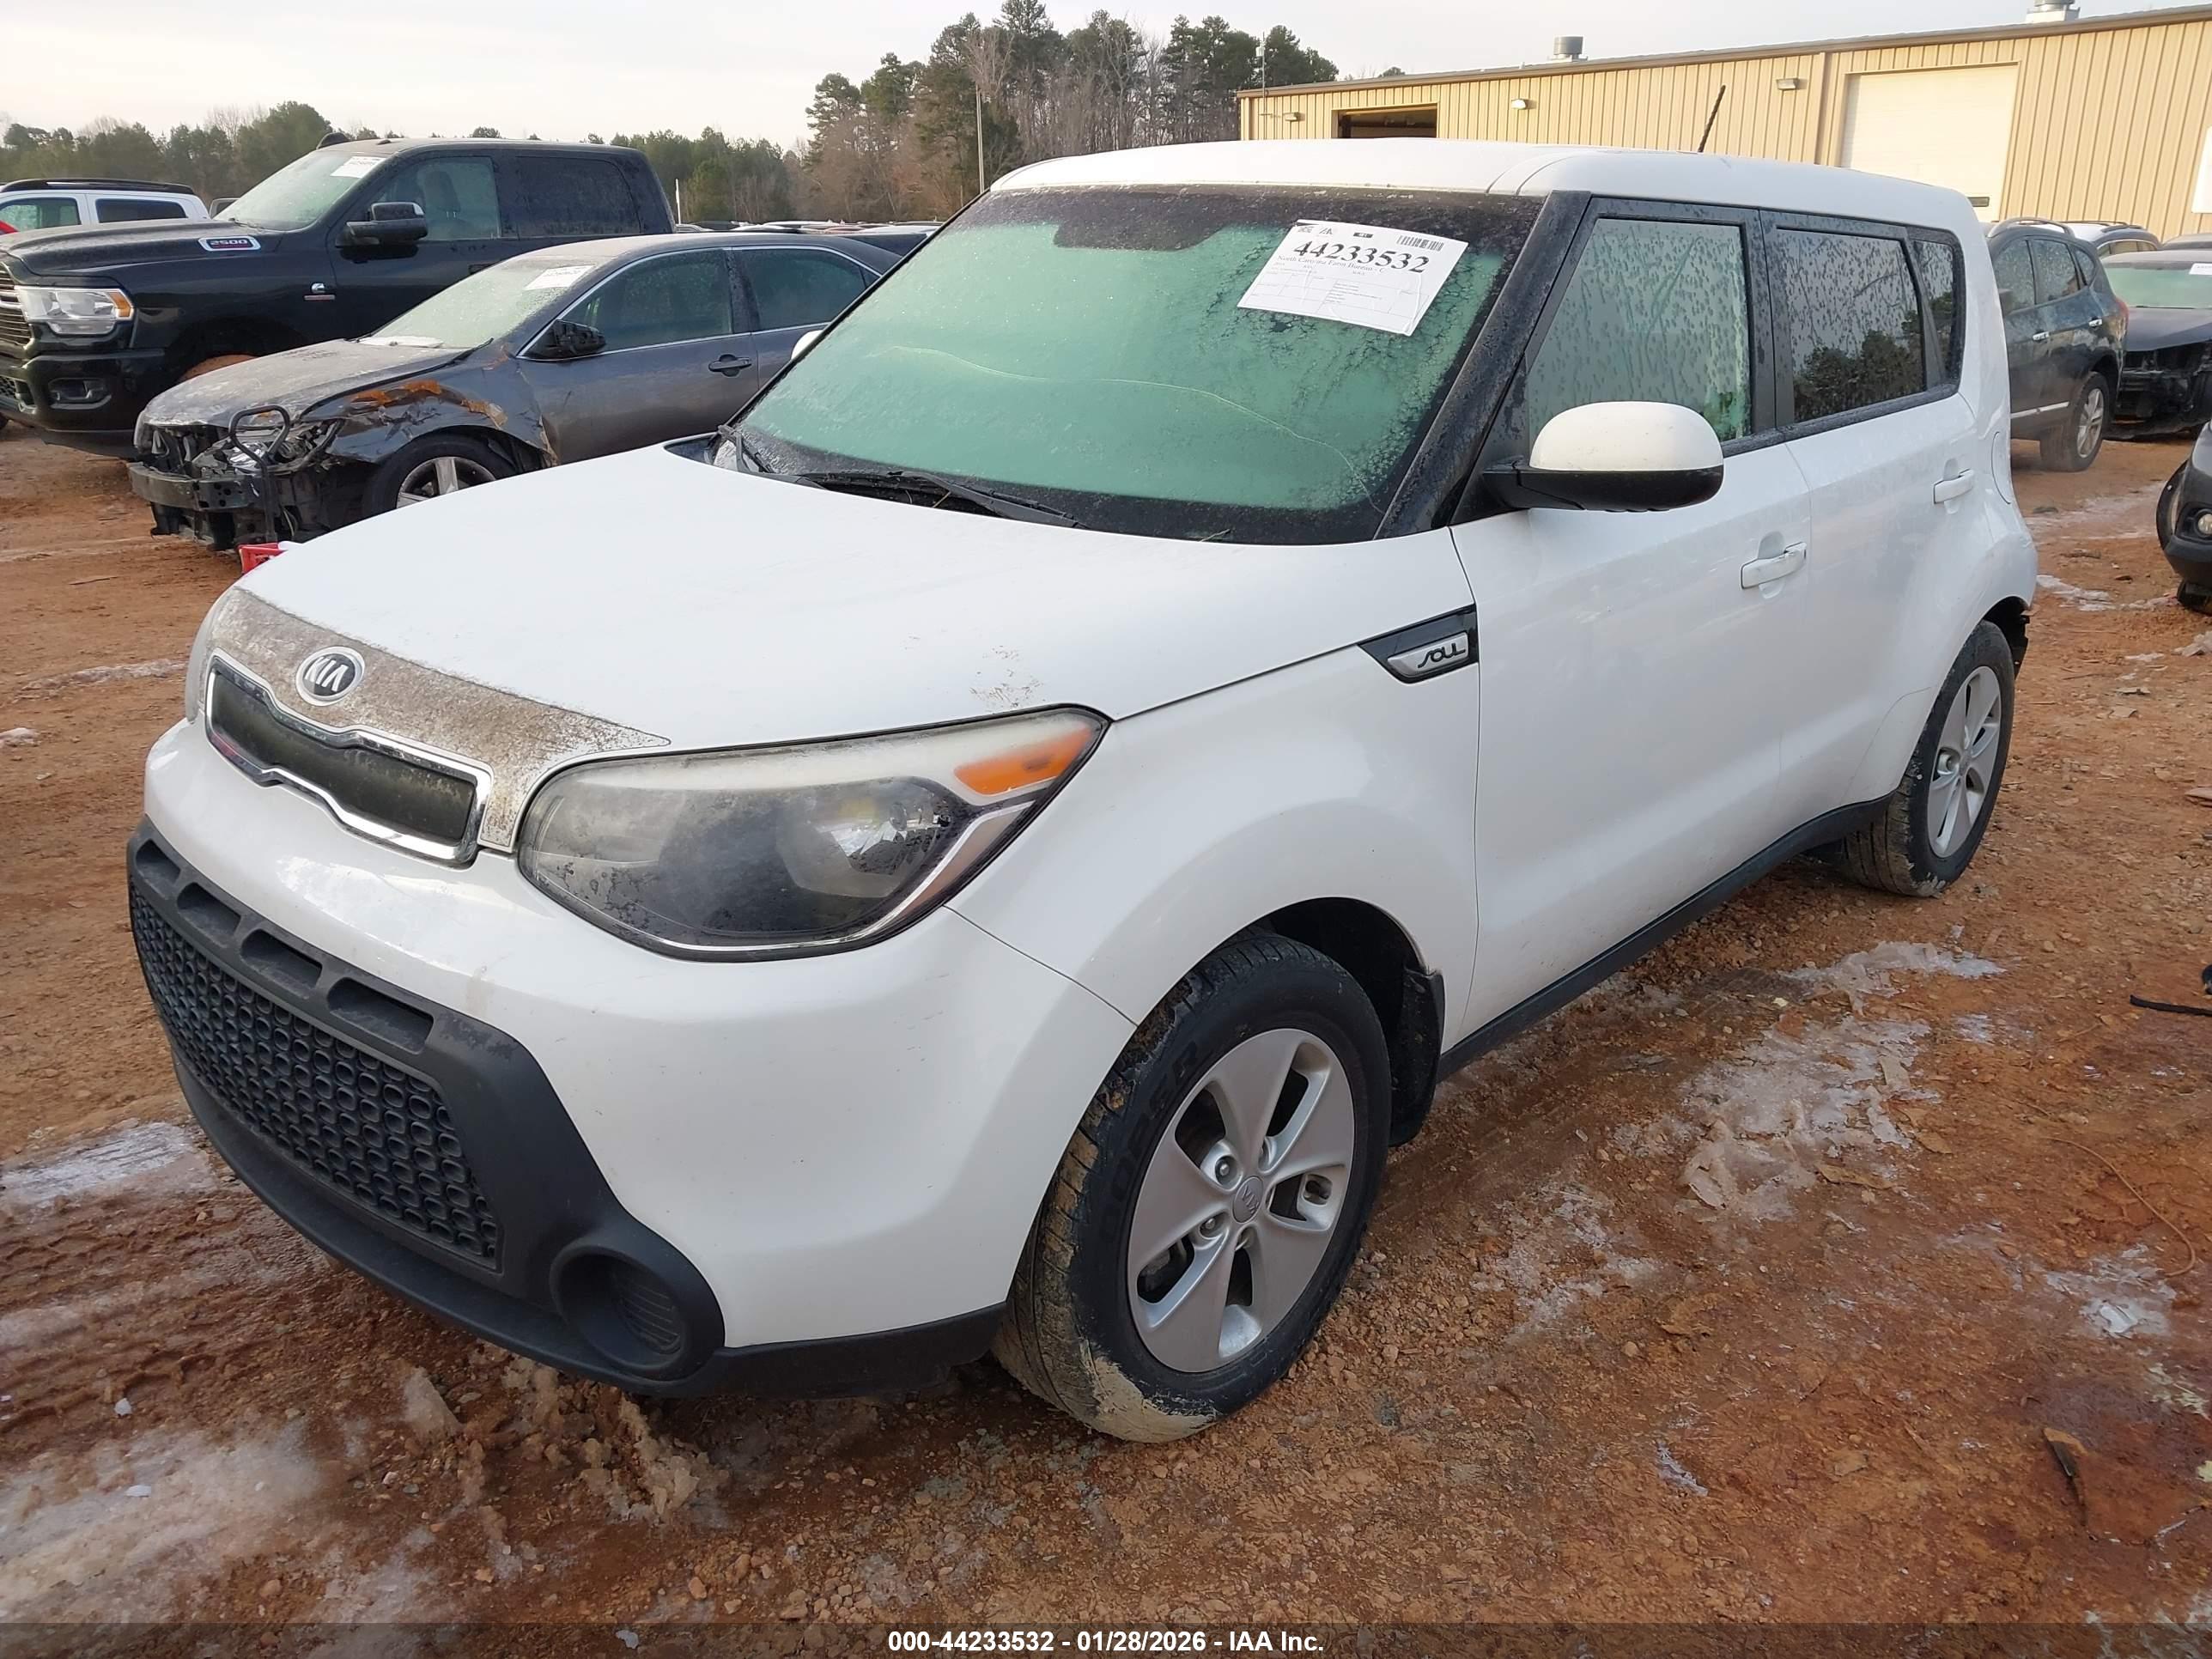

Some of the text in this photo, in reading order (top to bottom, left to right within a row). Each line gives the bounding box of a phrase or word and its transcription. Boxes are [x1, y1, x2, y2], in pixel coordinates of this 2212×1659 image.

[1293, 240, 1430, 273] 44233532
[1347, 262, 1373, 271] Bureau
[1417, 642, 1466, 669] SOUL
[304, 656, 349, 692] KIA
